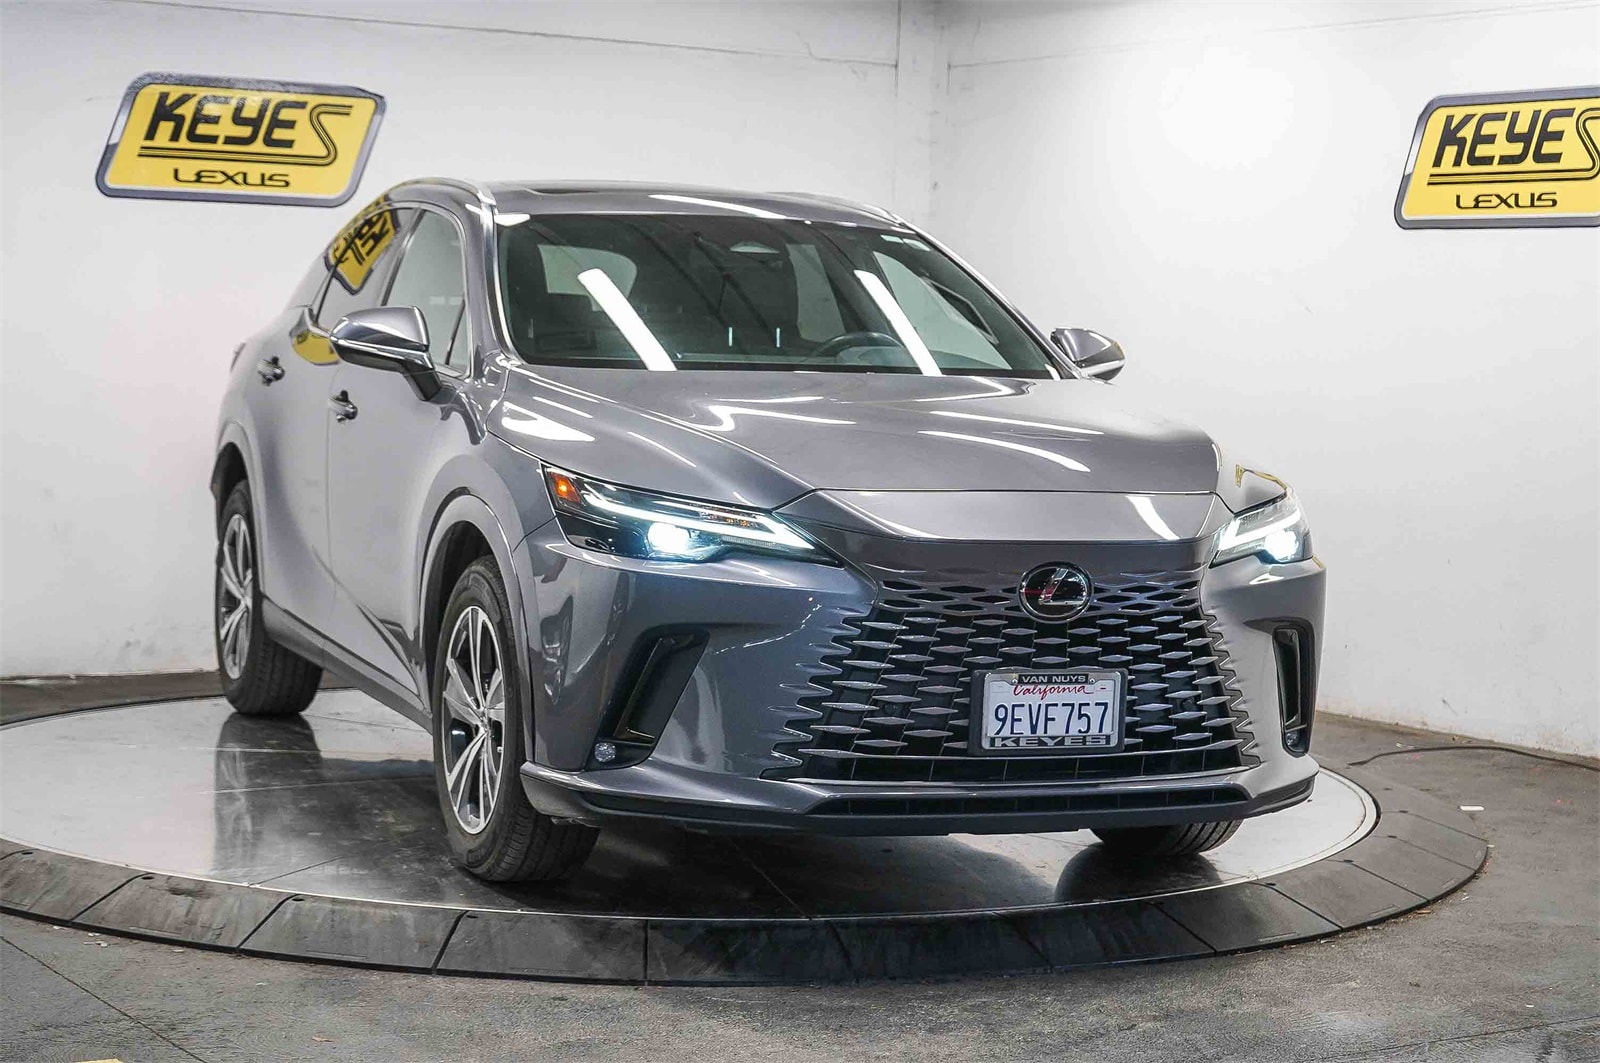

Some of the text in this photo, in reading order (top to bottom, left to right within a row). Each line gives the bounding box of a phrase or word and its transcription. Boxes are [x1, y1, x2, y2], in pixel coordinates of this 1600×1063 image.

[143, 91, 354, 166] KEYES
[173, 168, 290, 188] LEXUS
[1455, 191, 1558, 209] LEXUS
[1021, 675, 1087, 683] VAN NUYS
[1012, 683, 1095, 701] California
[994, 702, 1109, 736] 9EVF757
[994, 736, 1107, 747] KEYES
